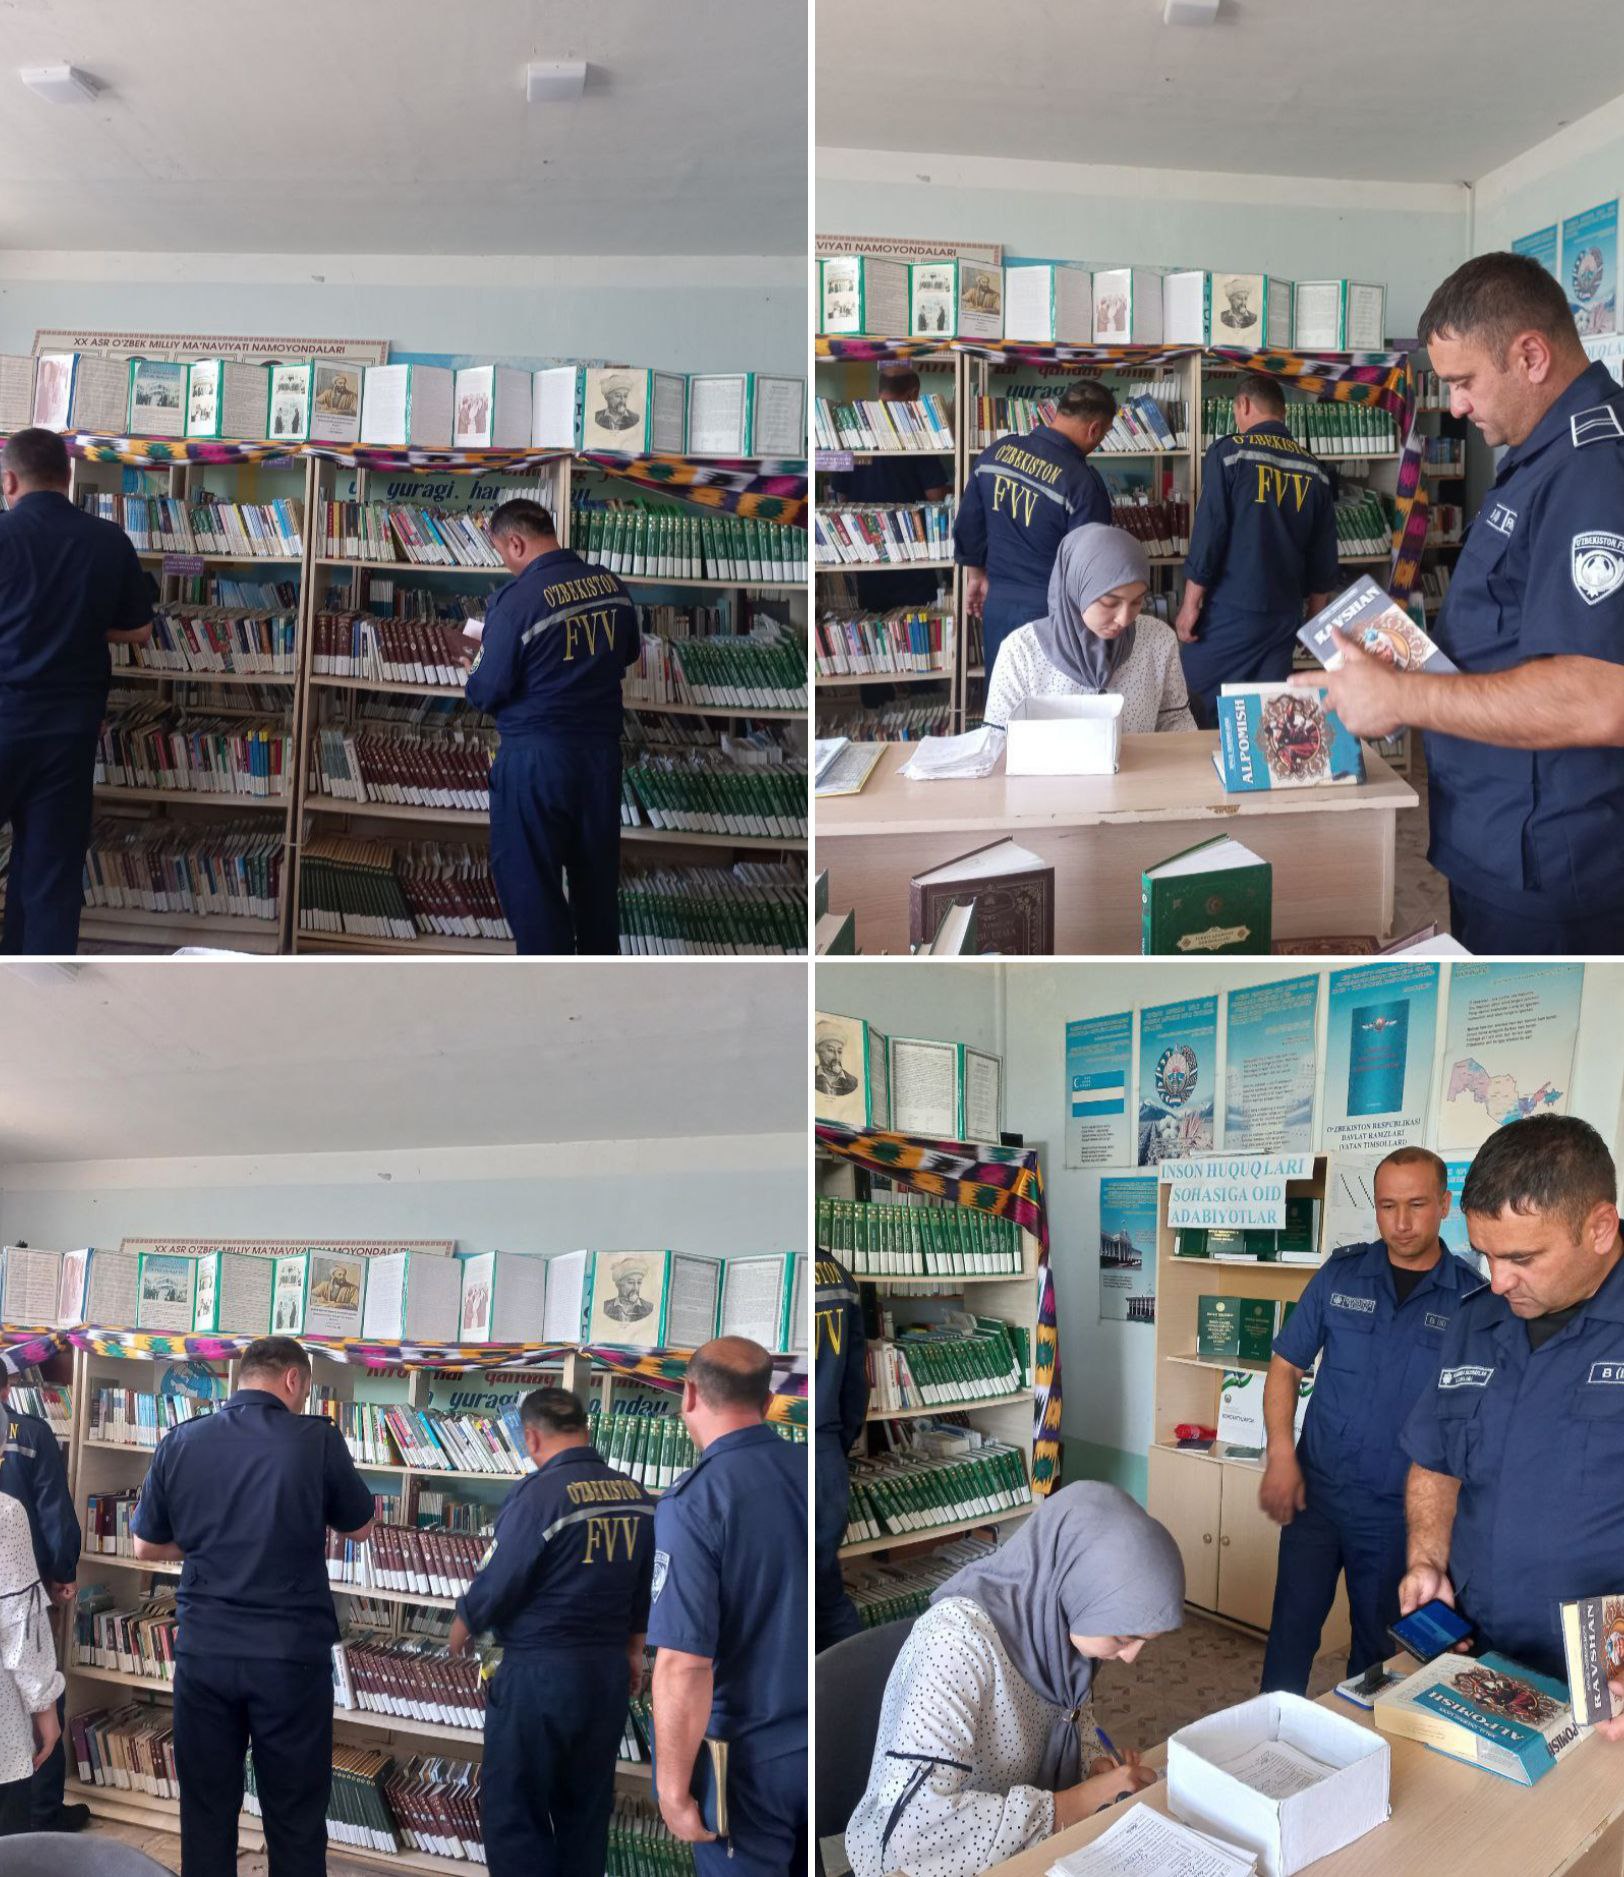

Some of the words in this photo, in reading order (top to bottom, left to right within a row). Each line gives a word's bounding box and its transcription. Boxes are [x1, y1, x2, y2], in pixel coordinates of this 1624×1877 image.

[855, 243, 957, 256] NAMOYONDALARI
[73, 338, 88, 346] XX
[90, 338, 109, 347] ASR
[149, 341, 180, 349] MILLIY
[251, 343, 346, 354] NAMOYONDALARI
[992, 473, 1038, 528] FVV
[1255, 464, 1312, 512] FVV
[563, 609, 617, 661] FVV
[1234, 698, 1253, 784] ALPOMISH
[1161, 1163, 1203, 1179] INSON
[1206, 1158, 1305, 1180] HUQUQLARI
[1174, 1186, 1249, 1202] SOHASIGA
[1252, 1185, 1281, 1201] OID
[1170, 1208, 1278, 1224] ADABIYOTLAR
[154, 1245, 166, 1253] XX
[169, 1245, 187, 1253] ASR
[1602, 1368, 1611, 1378] B
[582, 1516, 640, 1563] FVV
[1587, 1604, 1602, 1708] RAVSHAN
[1427, 1690, 1526, 1742] ALPOMISH
